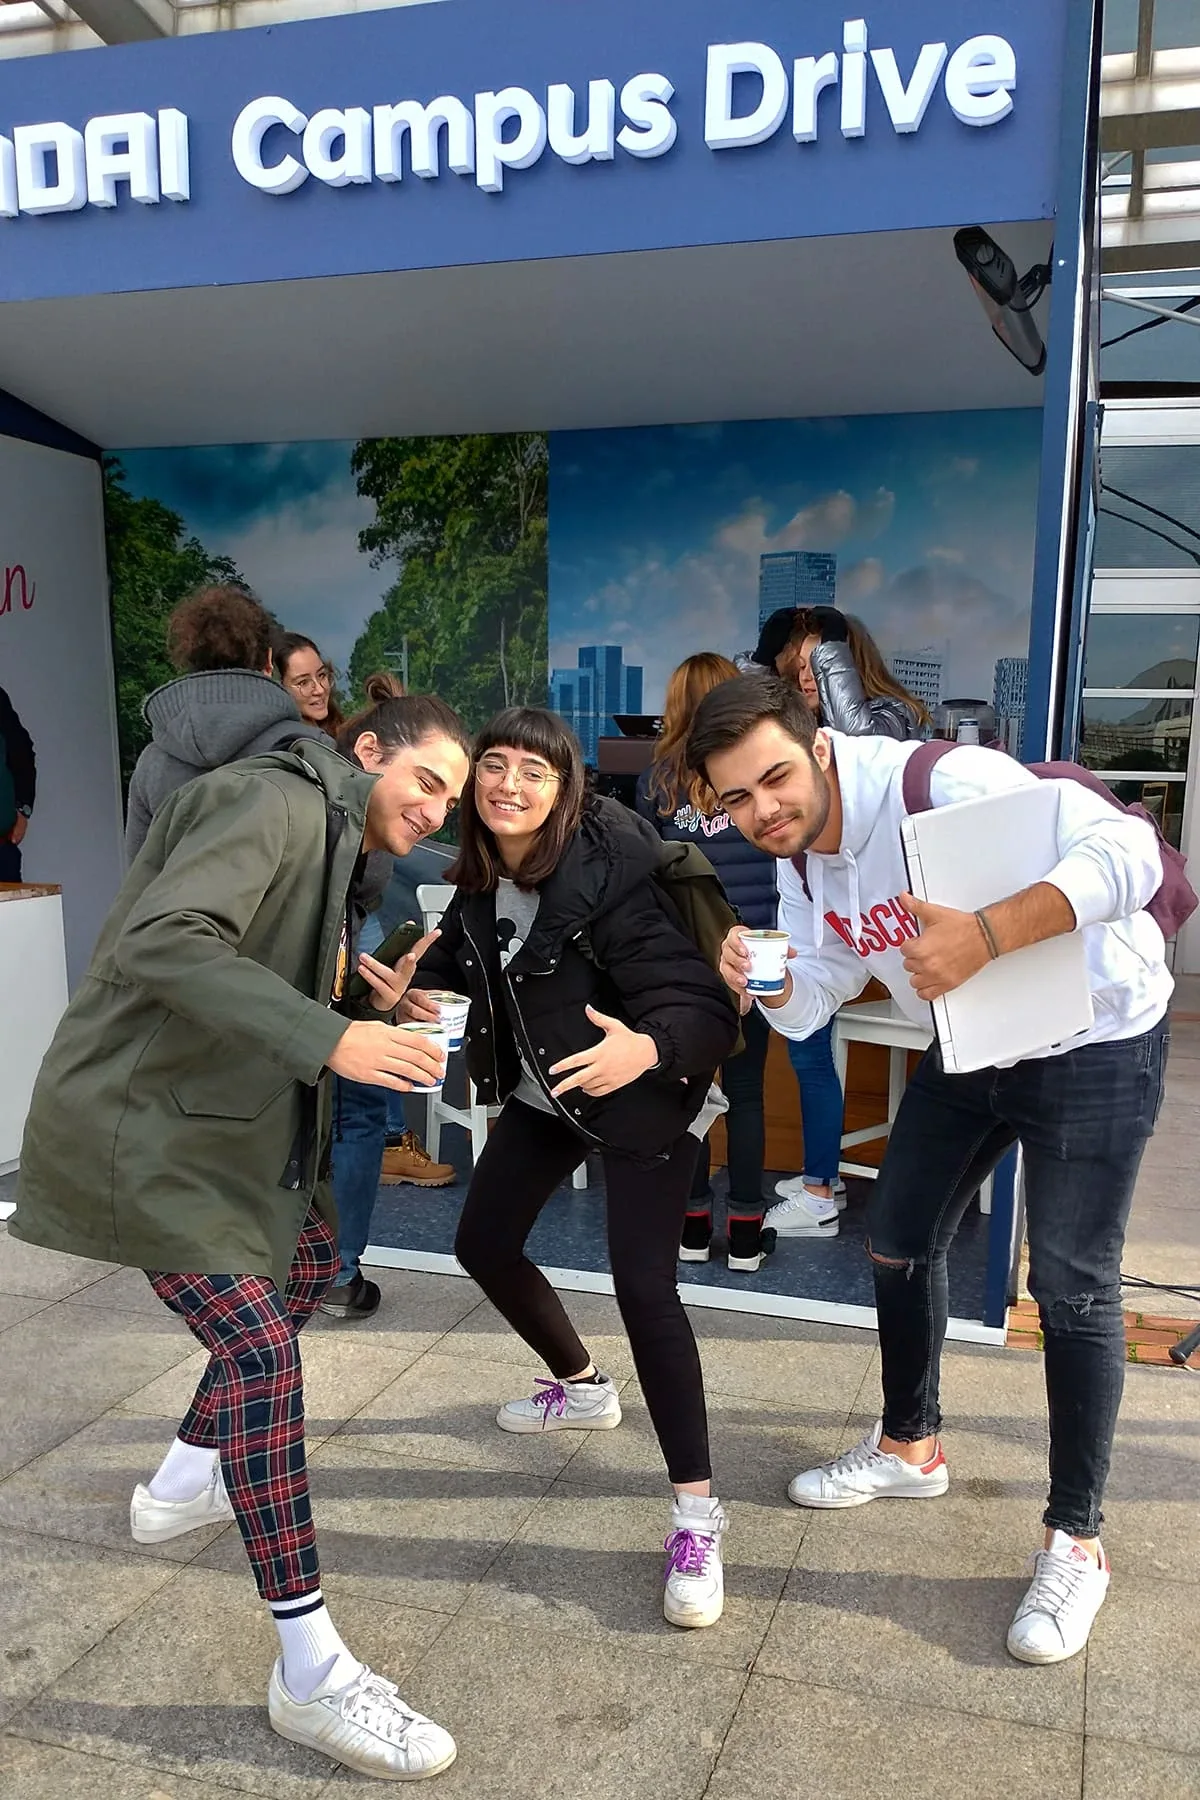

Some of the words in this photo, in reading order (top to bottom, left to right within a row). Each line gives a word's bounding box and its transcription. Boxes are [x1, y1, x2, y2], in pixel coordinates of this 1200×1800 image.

[0, 108, 190, 217] DAI
[232, 72, 677, 195] Campus
[704, 18, 1017, 151] Drive
[0, 564, 36, 616] n
